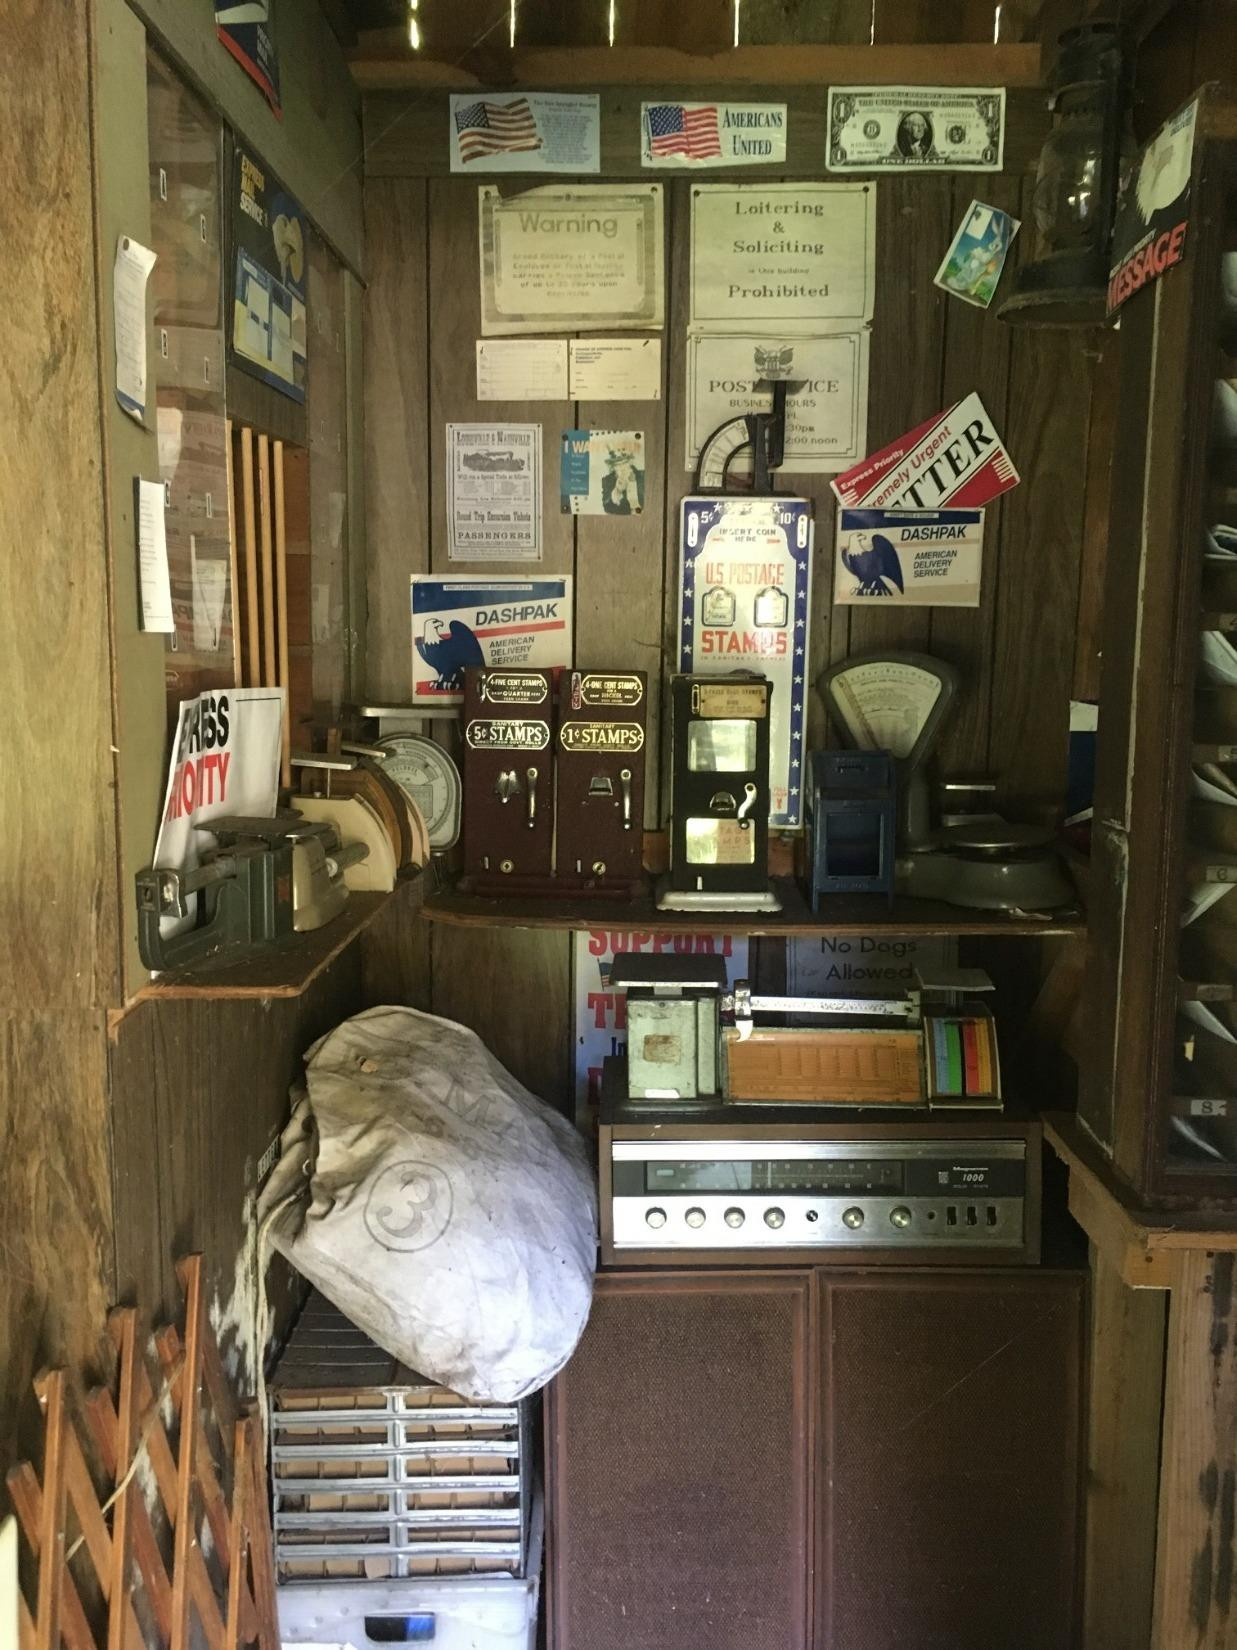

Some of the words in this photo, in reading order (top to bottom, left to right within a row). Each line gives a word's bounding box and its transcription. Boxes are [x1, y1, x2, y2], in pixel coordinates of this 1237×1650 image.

[722, 107, 783, 130] AMERICANS
[732, 137, 772, 157] UNITED
[735, 201, 824, 216] Loitering
[519, 213, 618, 238] Warning
[772, 220, 785, 233] &
[733, 240, 824, 255] Soliciting
[728, 284, 829, 298] Prohibited
[868, 467, 910, 508] remely
[910, 426, 953, 471] Urgent
[892, 418, 994, 508] TTER
[458, 532, 531, 540] PASSENGERS
[719, 528, 752, 536] INSERT
[756, 528, 777, 536] COIN
[900, 525, 967, 541] DASHPAK
[914, 550, 957, 560] AMERICAN
[913, 559, 953, 569] DELIVERY
[729, 563, 785, 585] POSTAGE
[913, 568, 948, 578] SERVICE
[475, 602, 558, 627] DASHPAK
[489, 635, 535, 648] AMERICAN
[701, 630, 787, 654] STAMPS
[490, 644, 532, 657] DELIVERY
[491, 653, 529, 666] SERVICE
[507, 678, 520, 686] CENT
[521, 679, 543, 687] STAMPS
[603, 681, 617, 689] CENT
[617, 681, 638, 690] STAMPS
[474, 725, 487, 741] 5¢
[489, 726, 542, 742] STAMPS
[567, 728, 580, 743] 1¢
[581, 728, 638, 744] STAMPS
[821, 936, 852, 954] No
[860, 936, 918, 958] Dogs
[826, 963, 913, 981] Allowed
[963, 1174, 984, 1182] 1000
[376, 1170, 437, 1239] 3
